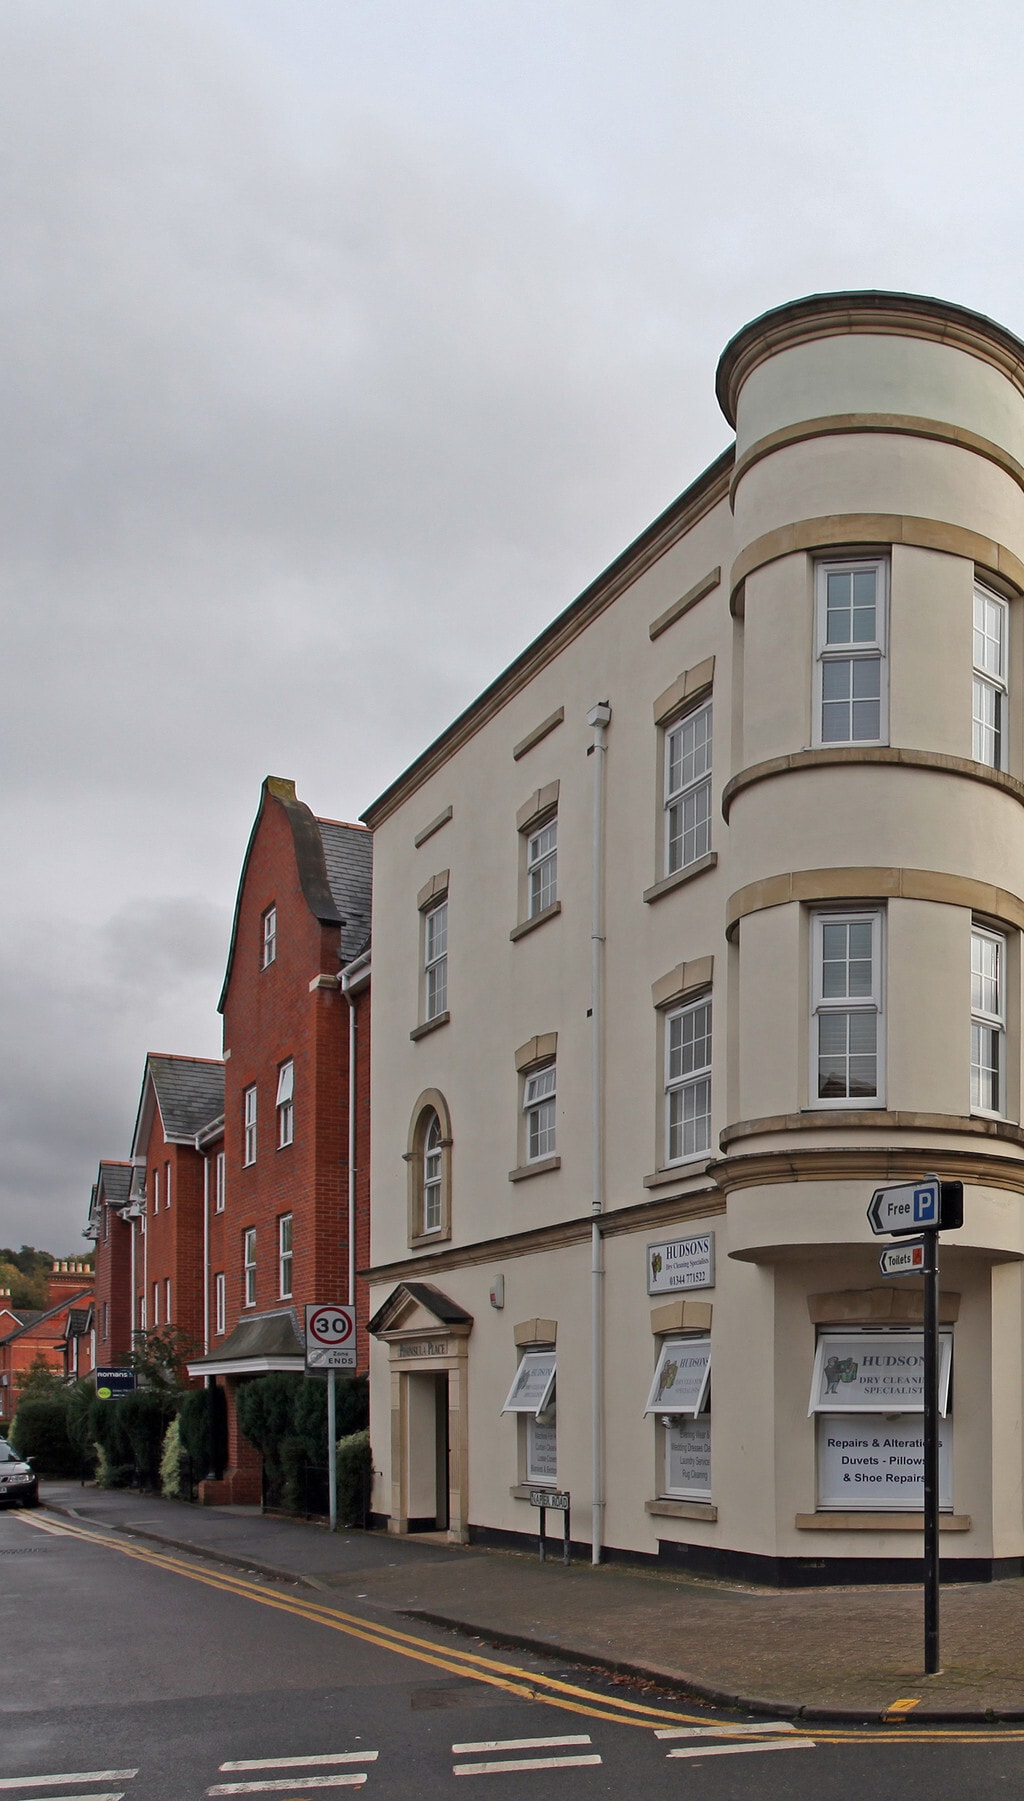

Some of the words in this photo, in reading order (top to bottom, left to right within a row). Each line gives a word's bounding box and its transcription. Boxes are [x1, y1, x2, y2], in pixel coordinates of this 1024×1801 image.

[888, 1203, 910, 1216] Free
[666, 1239, 709, 1260] HUDSONS
[690, 1258, 709, 1267] Specialists
[888, 1254, 911, 1266] Toilets
[670, 1275, 685, 1286] 01344
[686, 1272, 706, 1283] 771522
[316, 1318, 346, 1334] 30
[862, 1356, 925, 1366] HUDSON
[688, 1443, 704, 1452] Dresses
[828, 1438, 868, 1449] Repairs
[872, 1438, 880, 1448] &
[883, 1438, 943, 1448] Alteratis
[680, 1457, 695, 1467] Laundry
[842, 1456, 879, 1465] Duvets
[690, 1469, 708, 1481] Cleaning
[843, 1473, 851, 1482] &
[855, 1473, 882, 1482] Shoe
[886, 1473, 925, 1484] Repairs
[552, 1496, 567, 1508] ROAD
